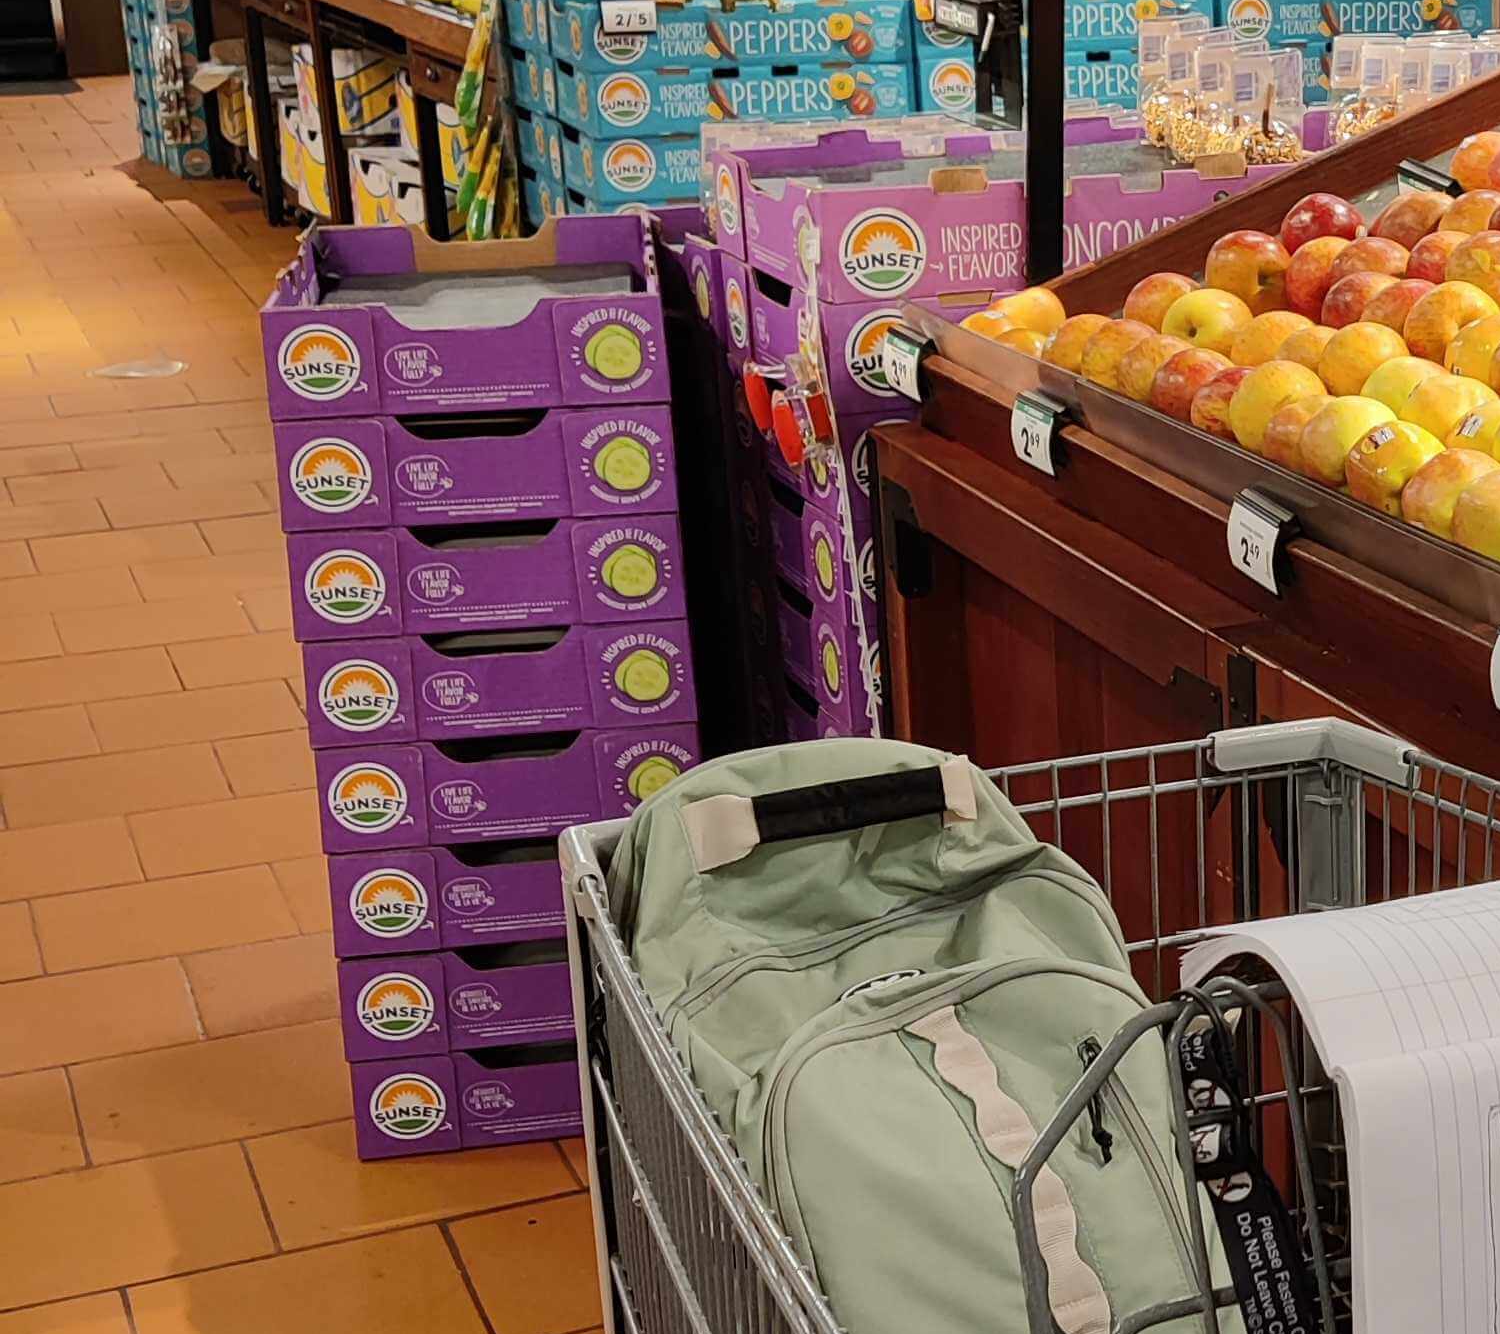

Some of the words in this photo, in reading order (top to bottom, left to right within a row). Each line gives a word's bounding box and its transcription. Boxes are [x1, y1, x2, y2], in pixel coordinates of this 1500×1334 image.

[1064, 2, 1138, 37] EPPERS
[1279, 4, 1321, 21] INSPIRED
[1339, 1, 1423, 33] PEPPERS
[658, 22, 706, 41] INSPIRED
[730, 18, 832, 54] PEPPERS
[597, 38, 646, 51] SUNSET
[1064, 64, 1140, 97] EPPERS
[659, 83, 710, 101] INSPIRED
[731, 78, 833, 115] PEPPERS
[600, 101, 648, 113] SUNSET
[940, 222, 1022, 254] INSPIRED
[844, 251, 924, 277] SUNSET
[948, 251, 1019, 282] FLAVOR
[283, 362, 358, 381] SUNSET
[295, 474, 369, 493] SUNSET
[308, 587, 385, 605] SUNSET
[323, 696, 398, 714] SUNSET
[332, 798, 405, 816] SUNSET
[355, 903, 426, 922] SUNSET
[361, 1005, 434, 1025] SUNSET
[374, 1105, 445, 1125] SUNSET
[1236, 1211, 1252, 1237] Do
[1244, 1238, 1263, 1270] Not
[1256, 1215, 1283, 1269] Please
[1274, 1269, 1299, 1326] Fasten
[1253, 1269, 1277, 1321] Leave
